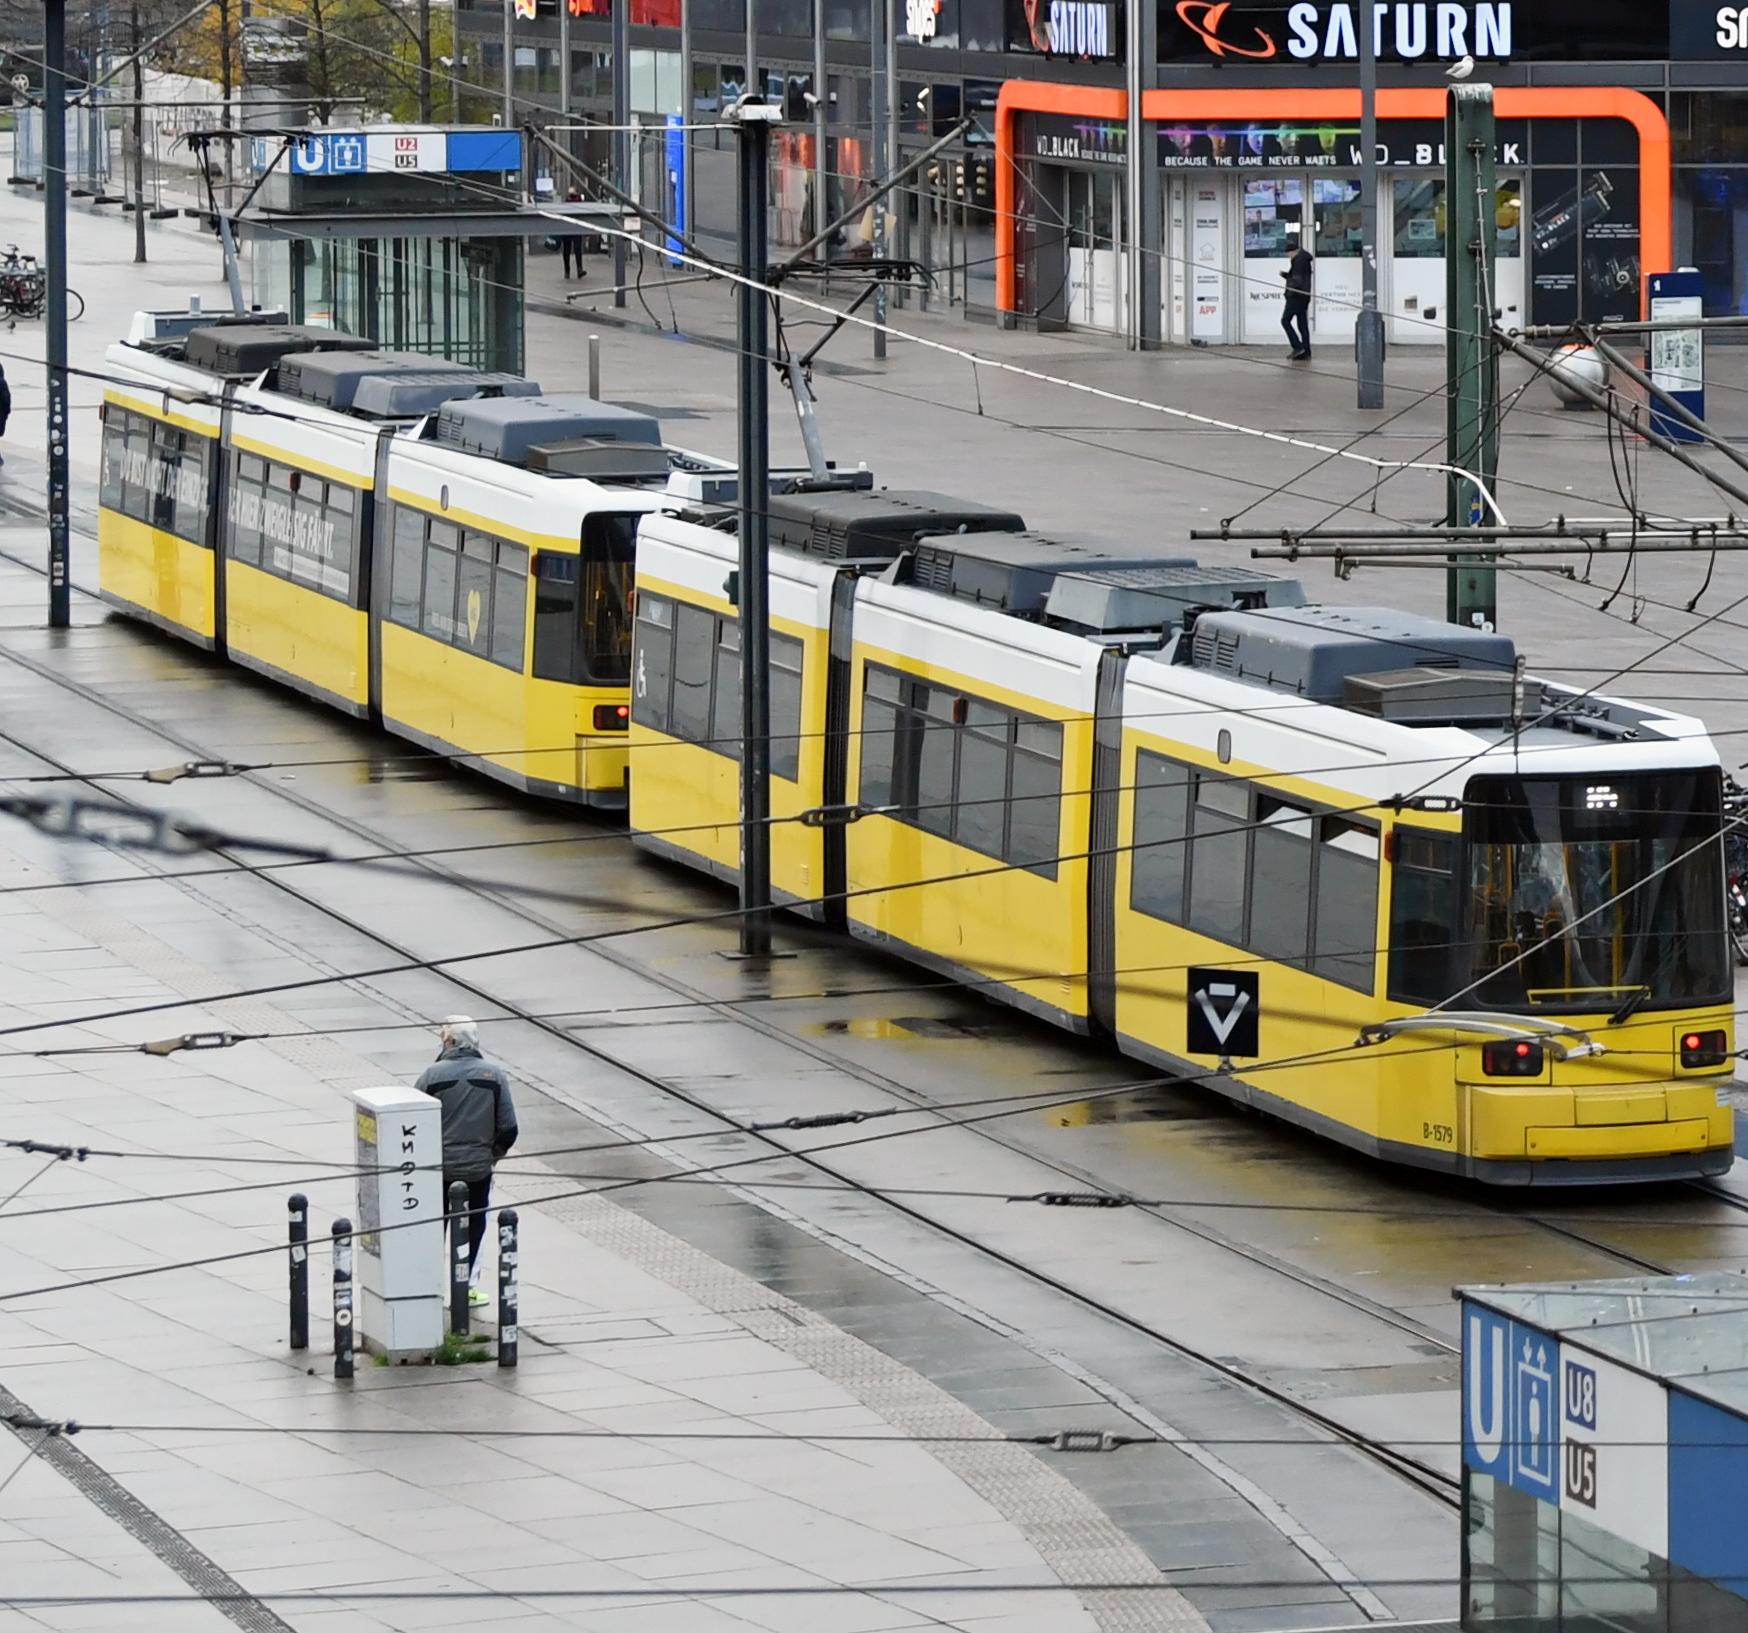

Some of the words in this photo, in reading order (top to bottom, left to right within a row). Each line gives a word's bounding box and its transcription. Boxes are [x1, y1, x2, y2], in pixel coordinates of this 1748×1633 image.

[1051, 0, 1107, 57] SATURN
[297, 136, 324, 171] U
[396, 139, 417, 150] U2
[396, 155, 417, 167] U5
[1165, 155, 1208, 166] BECAUSE
[1215, 155, 1232, 166] THE
[1238, 155, 1263, 166] GAME
[1268, 155, 1300, 166] NEVER
[1305, 155, 1337, 166] WAITS
[1422, 1122, 1454, 1145] B-1579
[1470, 1315, 1503, 1464] U
[1569, 1367, 1594, 1423] U8
[1569, 1442, 1594, 1500] U5
